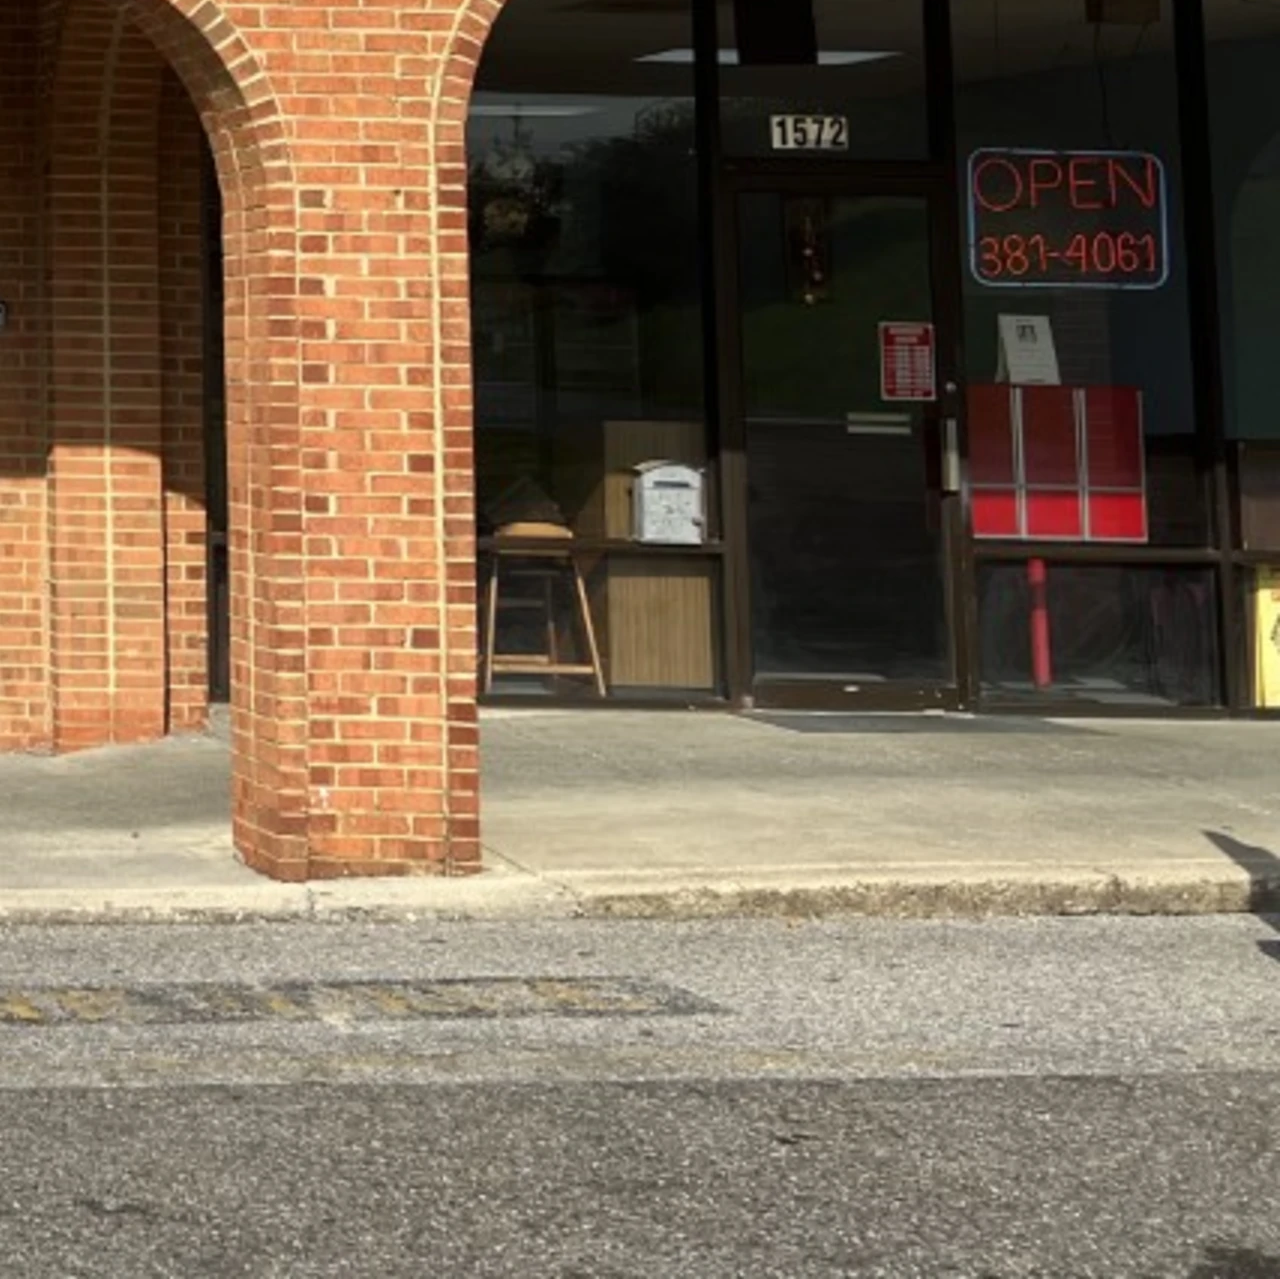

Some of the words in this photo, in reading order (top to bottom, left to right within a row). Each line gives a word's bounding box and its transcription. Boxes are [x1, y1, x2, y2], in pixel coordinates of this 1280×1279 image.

[775, 117, 846, 146] 1572
[975, 156, 1156, 212] OPEN
[980, 231, 1156, 277] 381-4061
